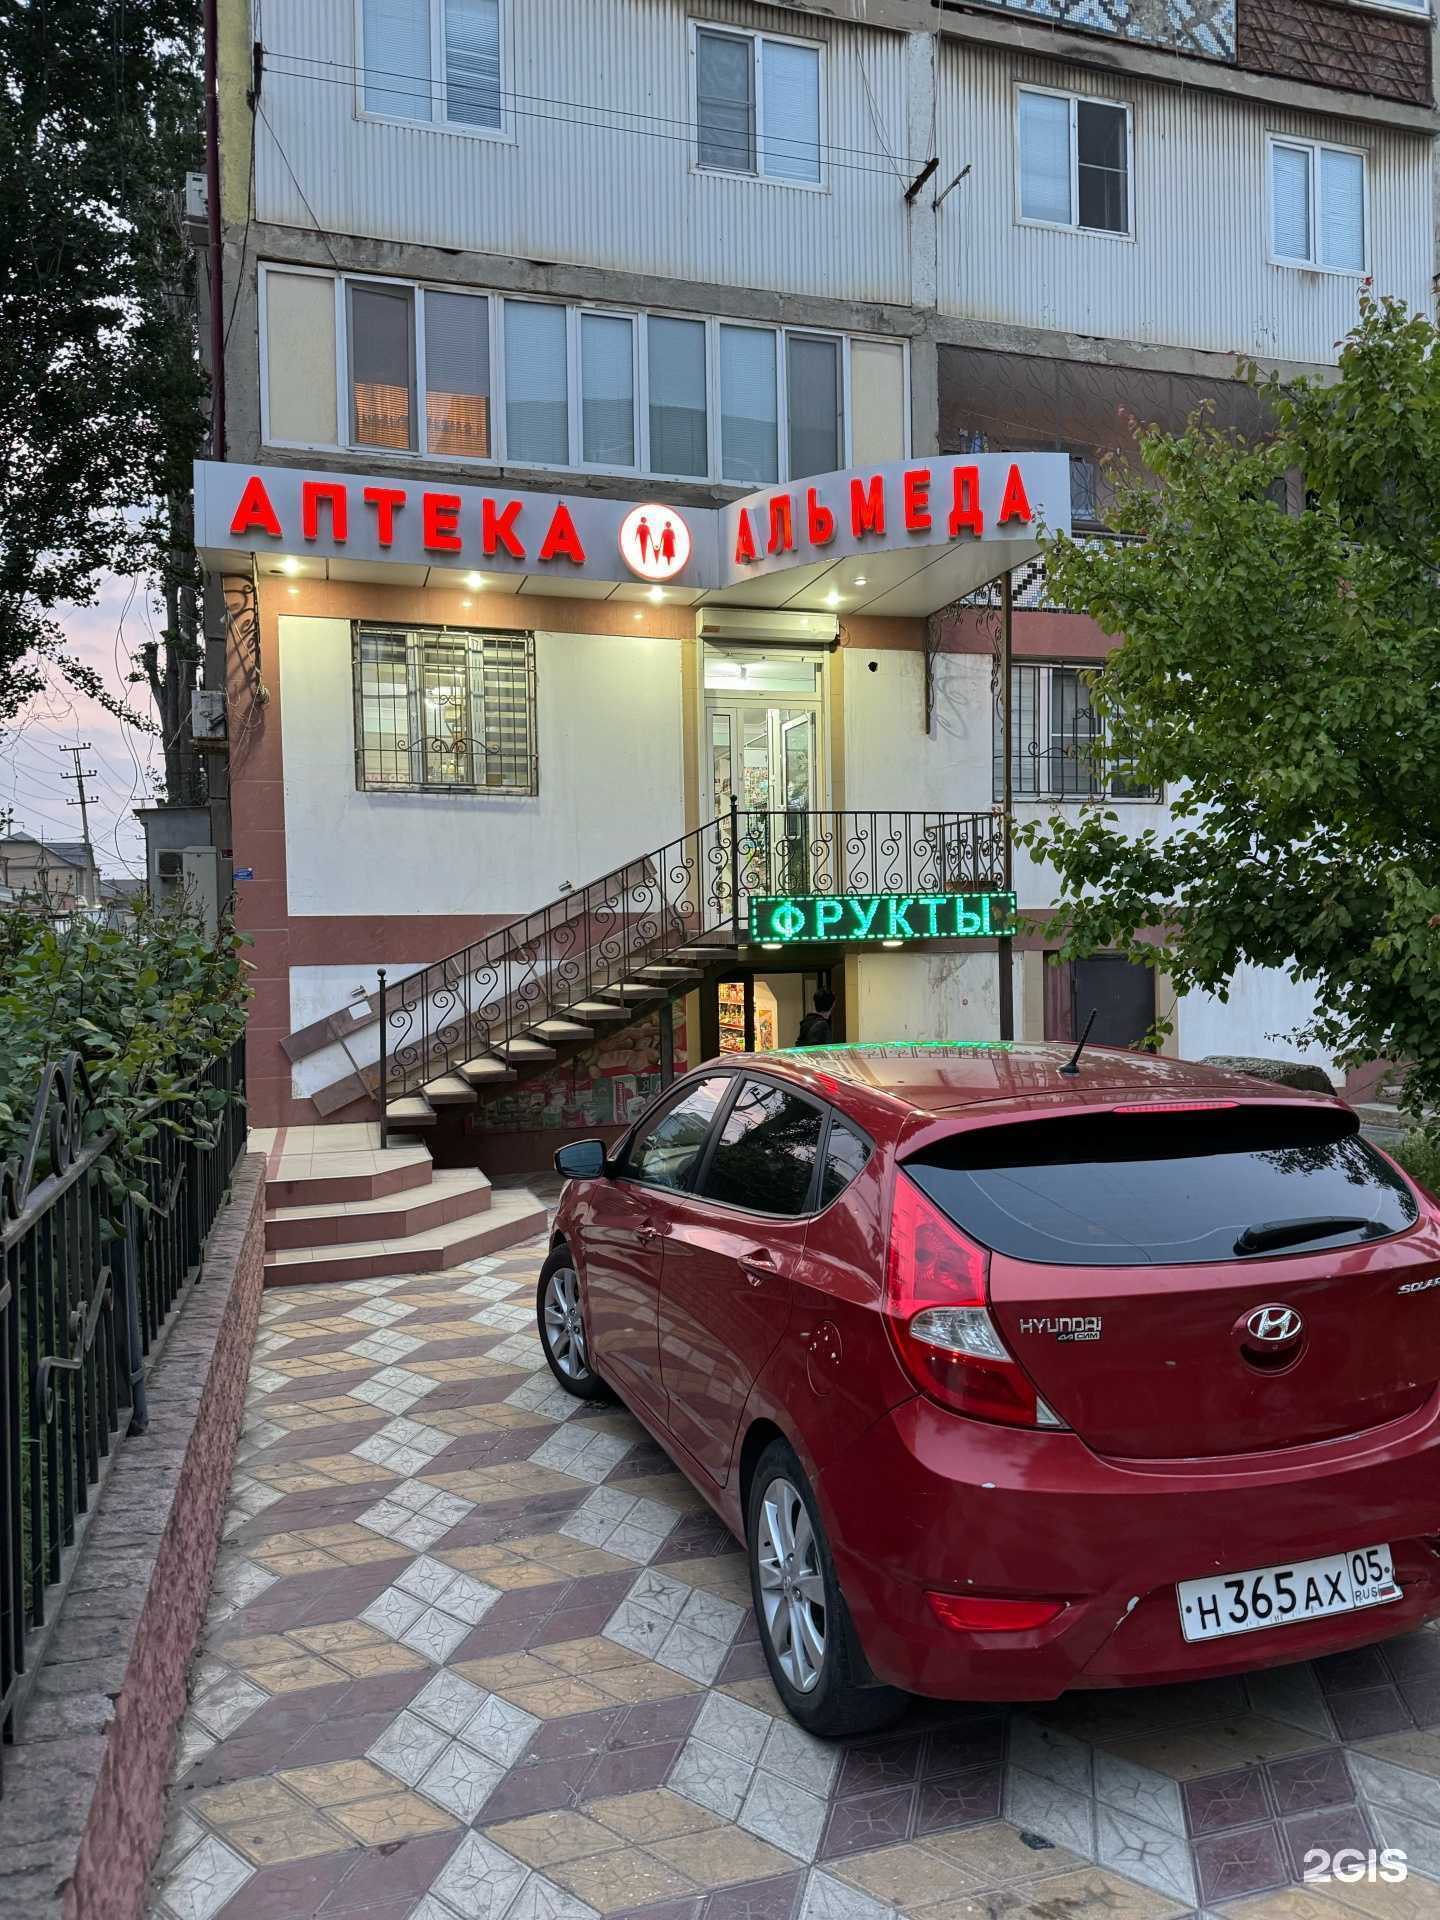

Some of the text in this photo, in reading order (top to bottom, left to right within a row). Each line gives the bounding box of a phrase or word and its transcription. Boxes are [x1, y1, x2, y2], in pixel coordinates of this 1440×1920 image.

[230, 475, 586, 564] АПТЕКА
[735, 463, 1032, 565] АЛЬМЕДА
[772, 897, 990, 938] ФРУКТЫ
[1020, 1317, 1102, 1334] HYUNDAI
[1355, 1587, 1378, 1601] RUS
